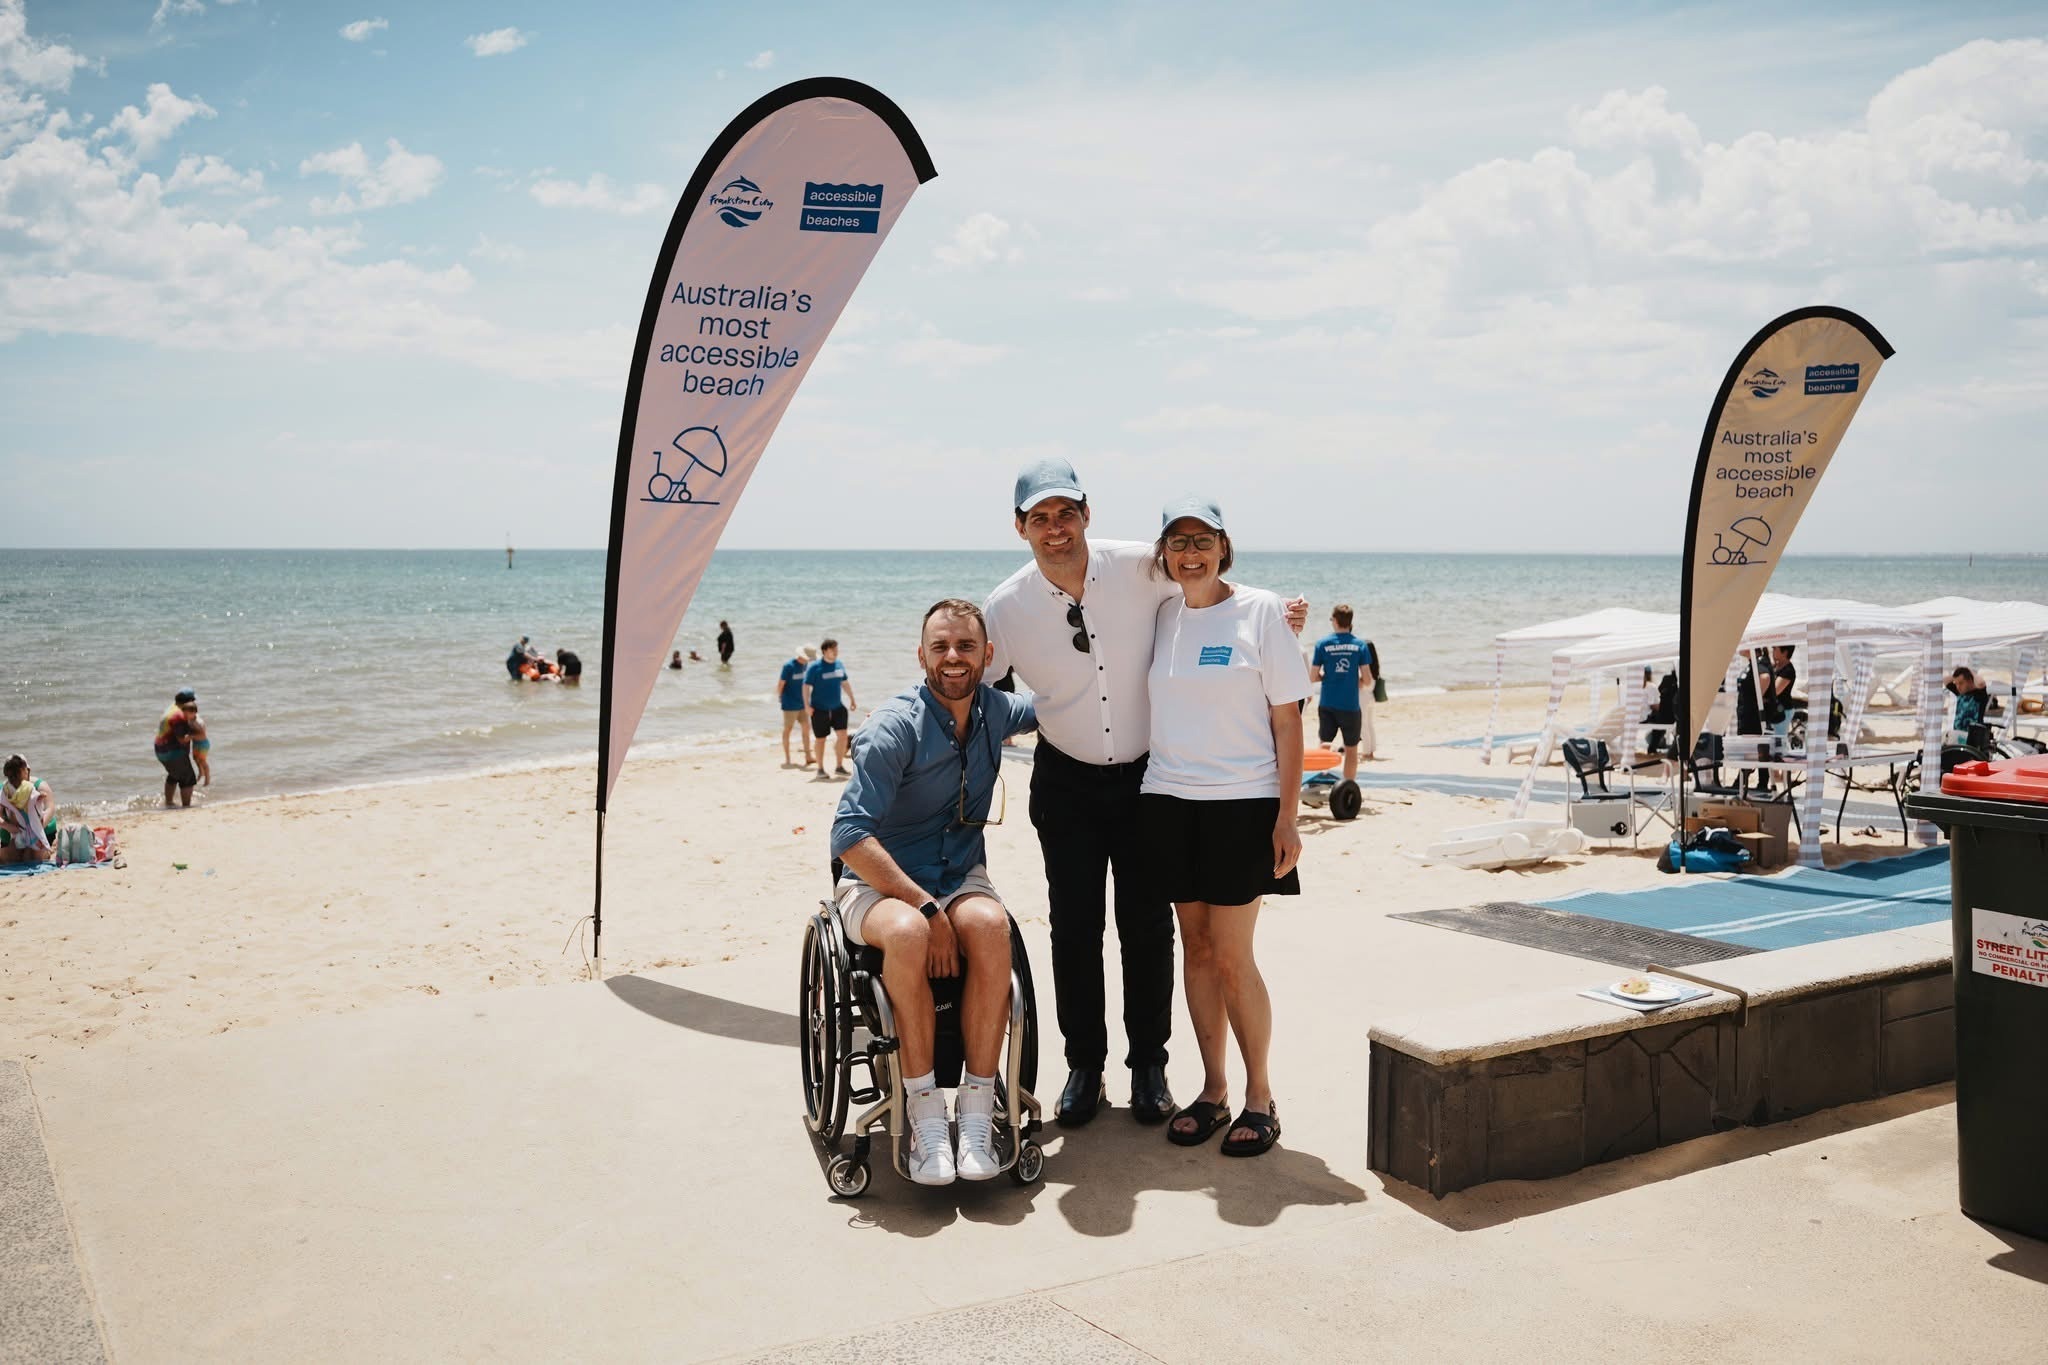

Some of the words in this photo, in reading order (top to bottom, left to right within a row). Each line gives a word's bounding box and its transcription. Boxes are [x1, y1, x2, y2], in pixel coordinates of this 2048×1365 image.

[810, 191, 876, 202] accessible
[806, 214, 860, 227] beaches
[671, 281, 813, 313] Australia's
[699, 315, 771, 339] most
[660, 343, 799, 369] accessible
[1808, 368, 1856, 377] accessible
[683, 369, 765, 396] beach
[1807, 383, 1846, 392] beaches
[1721, 430, 1818, 446] Australia's
[1744, 449, 1792, 464] most
[1716, 465, 1816, 481] accessible
[1736, 483, 1794, 498] beach
[1977, 939, 2022, 956] STREET
[1988, 953, 2028, 965] COMMERCIAL
[1992, 963, 2048, 982] PENALT
